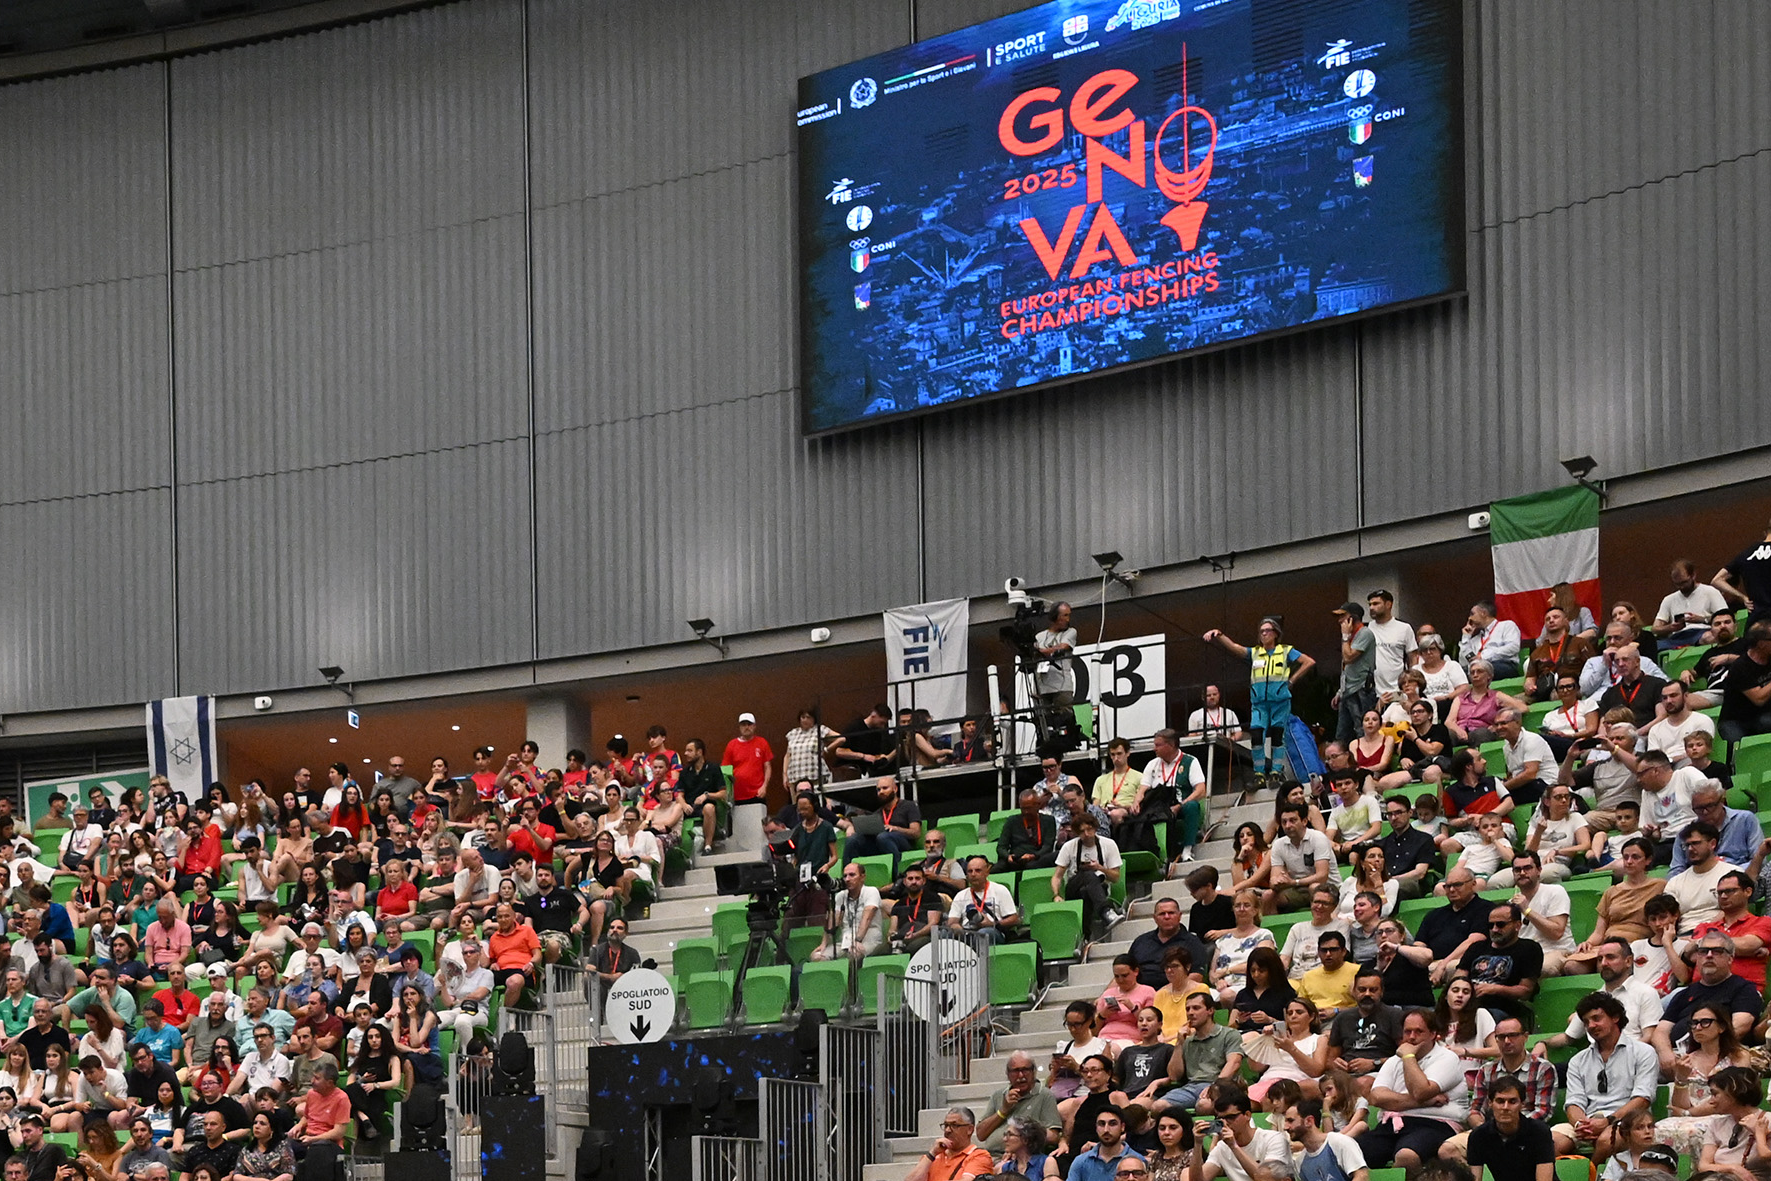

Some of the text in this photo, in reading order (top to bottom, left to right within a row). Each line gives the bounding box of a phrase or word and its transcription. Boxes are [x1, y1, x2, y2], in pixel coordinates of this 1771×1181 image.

[995, 31, 1046, 56] SPORT
[1005, 44, 1047, 62] SALUTE
[1326, 51, 1350, 69] FIE
[883, 83, 909, 95] Ministro
[927, 71, 945, 83] Sport
[953, 62, 976, 74] Giovani
[796, 103, 829, 118] uropean
[796, 109, 838, 126] ommission
[1374, 107, 1406, 122] CONI
[1003, 163, 1078, 200] 2025
[832, 188, 853, 205] FIE
[870, 240, 897, 253] CONI
[1000, 251, 1219, 317] EUROPEAN FENCING
[1000, 271, 1220, 339] CHAMPIONSHIPS
[902, 625, 930, 676] FIE
[910, 958, 978, 975] SPOLIATOIO
[939, 972, 957, 985] UD
[611, 986, 669, 1001] SPOGLIATOIO
[628, 998, 652, 1012] SUD
